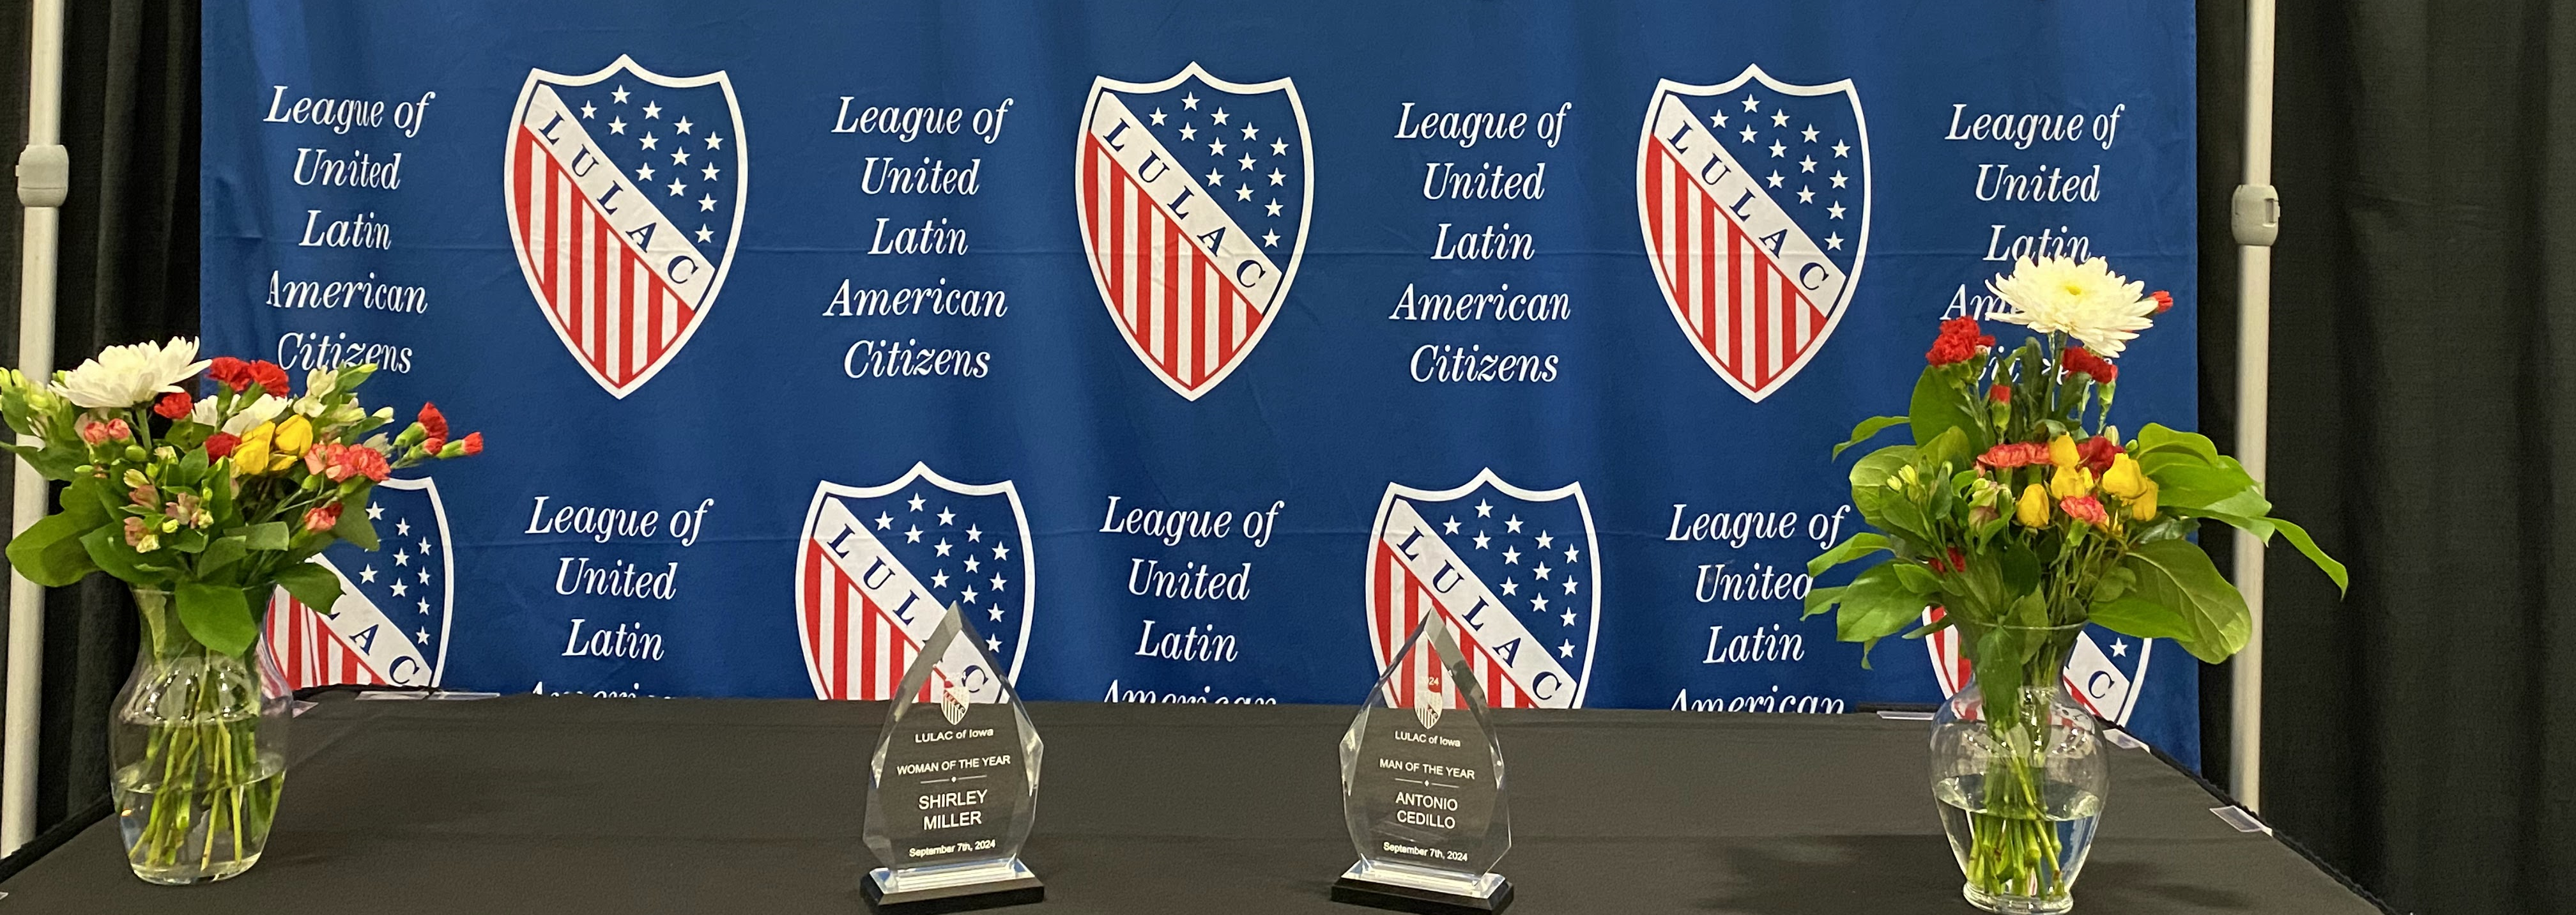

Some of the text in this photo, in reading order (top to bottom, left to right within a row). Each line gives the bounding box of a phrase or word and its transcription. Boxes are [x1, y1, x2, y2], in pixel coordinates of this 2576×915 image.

[263, 85, 436, 138] League of
[831, 96, 1014, 144] League of
[1394, 102, 1572, 148] League of
[1944, 103, 2126, 150] League of
[293, 148, 402, 190] United
[861, 157, 981, 195] United
[1423, 162, 1545, 200] United
[1975, 164, 2101, 202] United
[539, 111, 700, 285] LULAC
[1103, 118, 1266, 289] LULAC
[1666, 119, 1831, 291] LULAC
[298, 210, 392, 250] Latin
[867, 217, 969, 256] Latin
[1430, 222, 1535, 260] Latin
[1982, 224, 2092, 263] Latin
[266, 270, 428, 314] American
[822, 277, 1008, 318] American
[1388, 283, 1571, 321] American
[277, 332, 413, 374] Citizens
[844, 338, 990, 378] Citizens
[1410, 344, 1559, 383] Citizens
[525, 496, 714, 547] League of
[1099, 496, 1285, 548] League of
[1665, 504, 1850, 550] League of
[555, 557, 678, 600] United
[1128, 558, 1252, 601] United
[827, 523, 989, 694] LULC
[1397, 526, 1564, 702] LULAC
[562, 619, 664, 661] Latin
[1135, 620, 1238, 662] Latin
[1702, 623, 1805, 664] Latin
[915, 728, 994, 743] LULAC of Iowa
[1395, 730, 1461, 748] LULAC of Iowa
[896, 755, 1011, 776] WOMAN OF THE YEAR
[1379, 758, 1475, 780] MAN OF THE YEAR
[918, 788, 988, 810] SHIRLEY
[1395, 791, 1459, 811] ANTONIO
[1396, 810, 1457, 829] CEDILLO
[923, 810, 982, 831] MILLER
[908, 845, 956, 858] September
[974, 839, 996, 850] 2024
[1383, 842, 1429, 856] September
[1446, 850, 1468, 862] 2024
